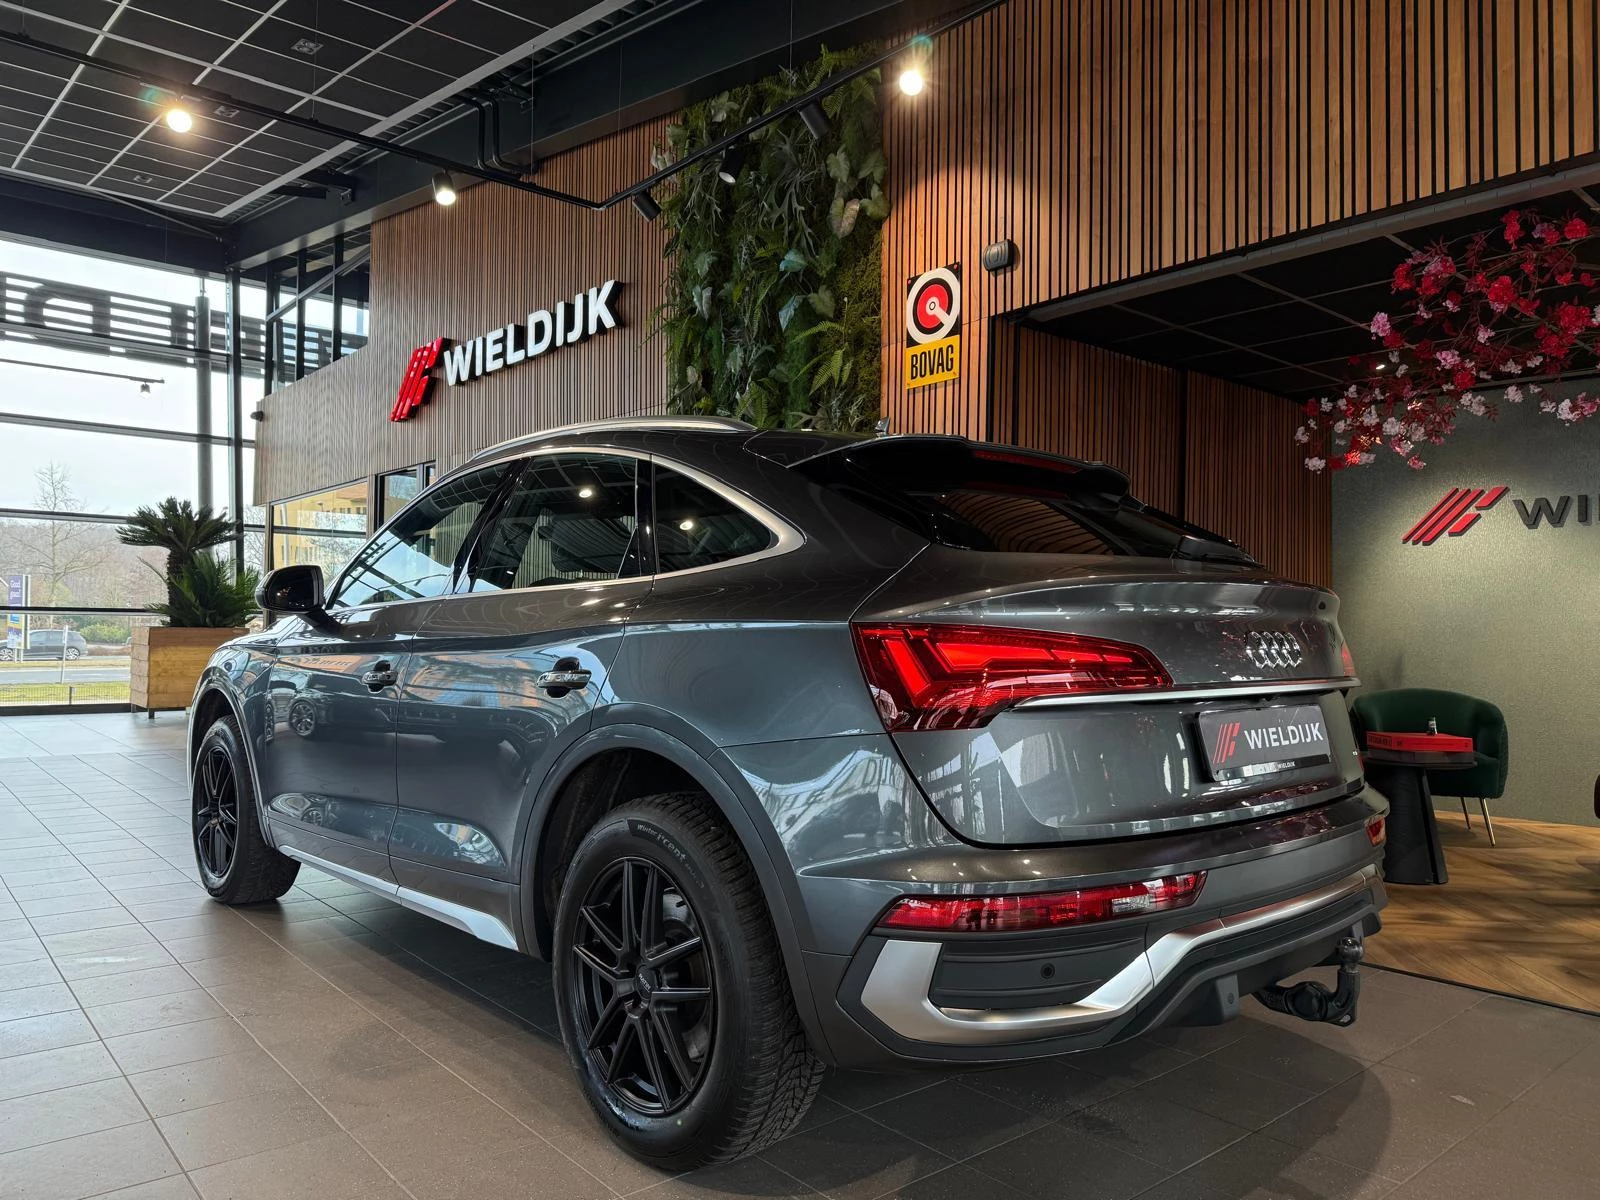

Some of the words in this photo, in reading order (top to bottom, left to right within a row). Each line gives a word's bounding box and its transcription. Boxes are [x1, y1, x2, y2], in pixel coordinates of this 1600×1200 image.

[443, 279, 618, 387] WIELDIJK
[910, 344, 954, 380] BOVAG
[1512, 494, 1600, 529] WI
[1244, 722, 1323, 750] WIELDIJK
